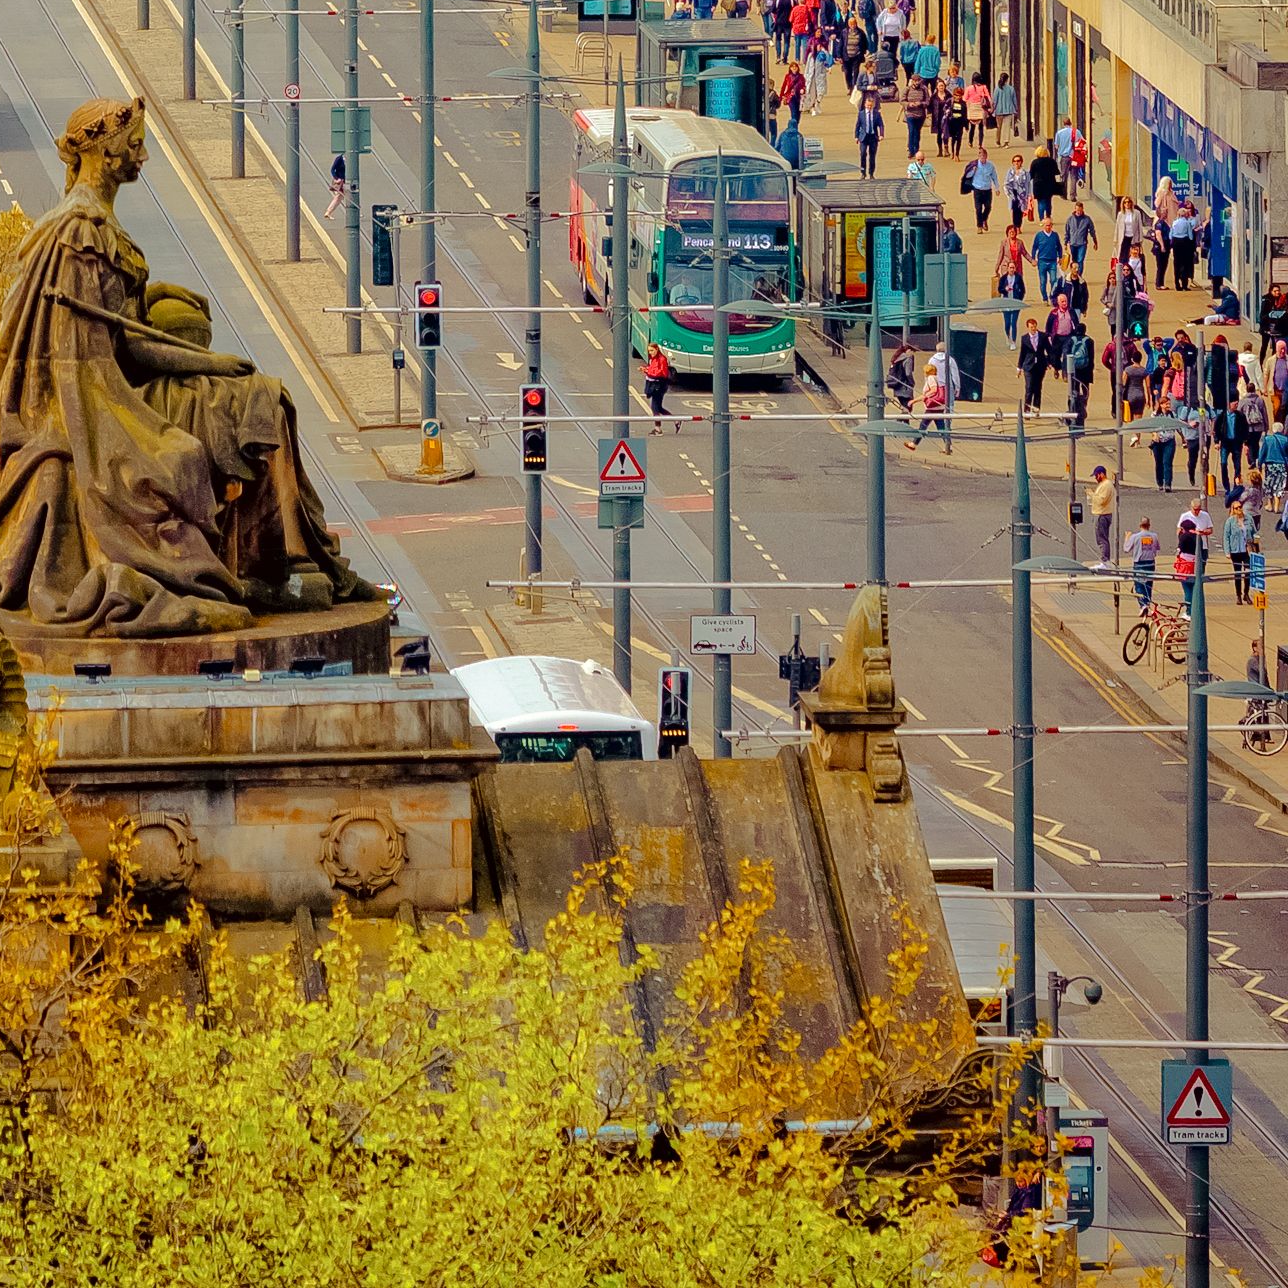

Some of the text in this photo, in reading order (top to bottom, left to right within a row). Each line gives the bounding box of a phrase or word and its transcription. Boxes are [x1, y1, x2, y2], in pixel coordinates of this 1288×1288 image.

[287, 86, 298, 95] 20
[684, 234, 771, 249] Pencand 113
[605, 484, 642, 492] Tram tracks
[701, 618, 744, 627] Give cyclists
[1173, 1130, 1225, 1139] Tram tracks
